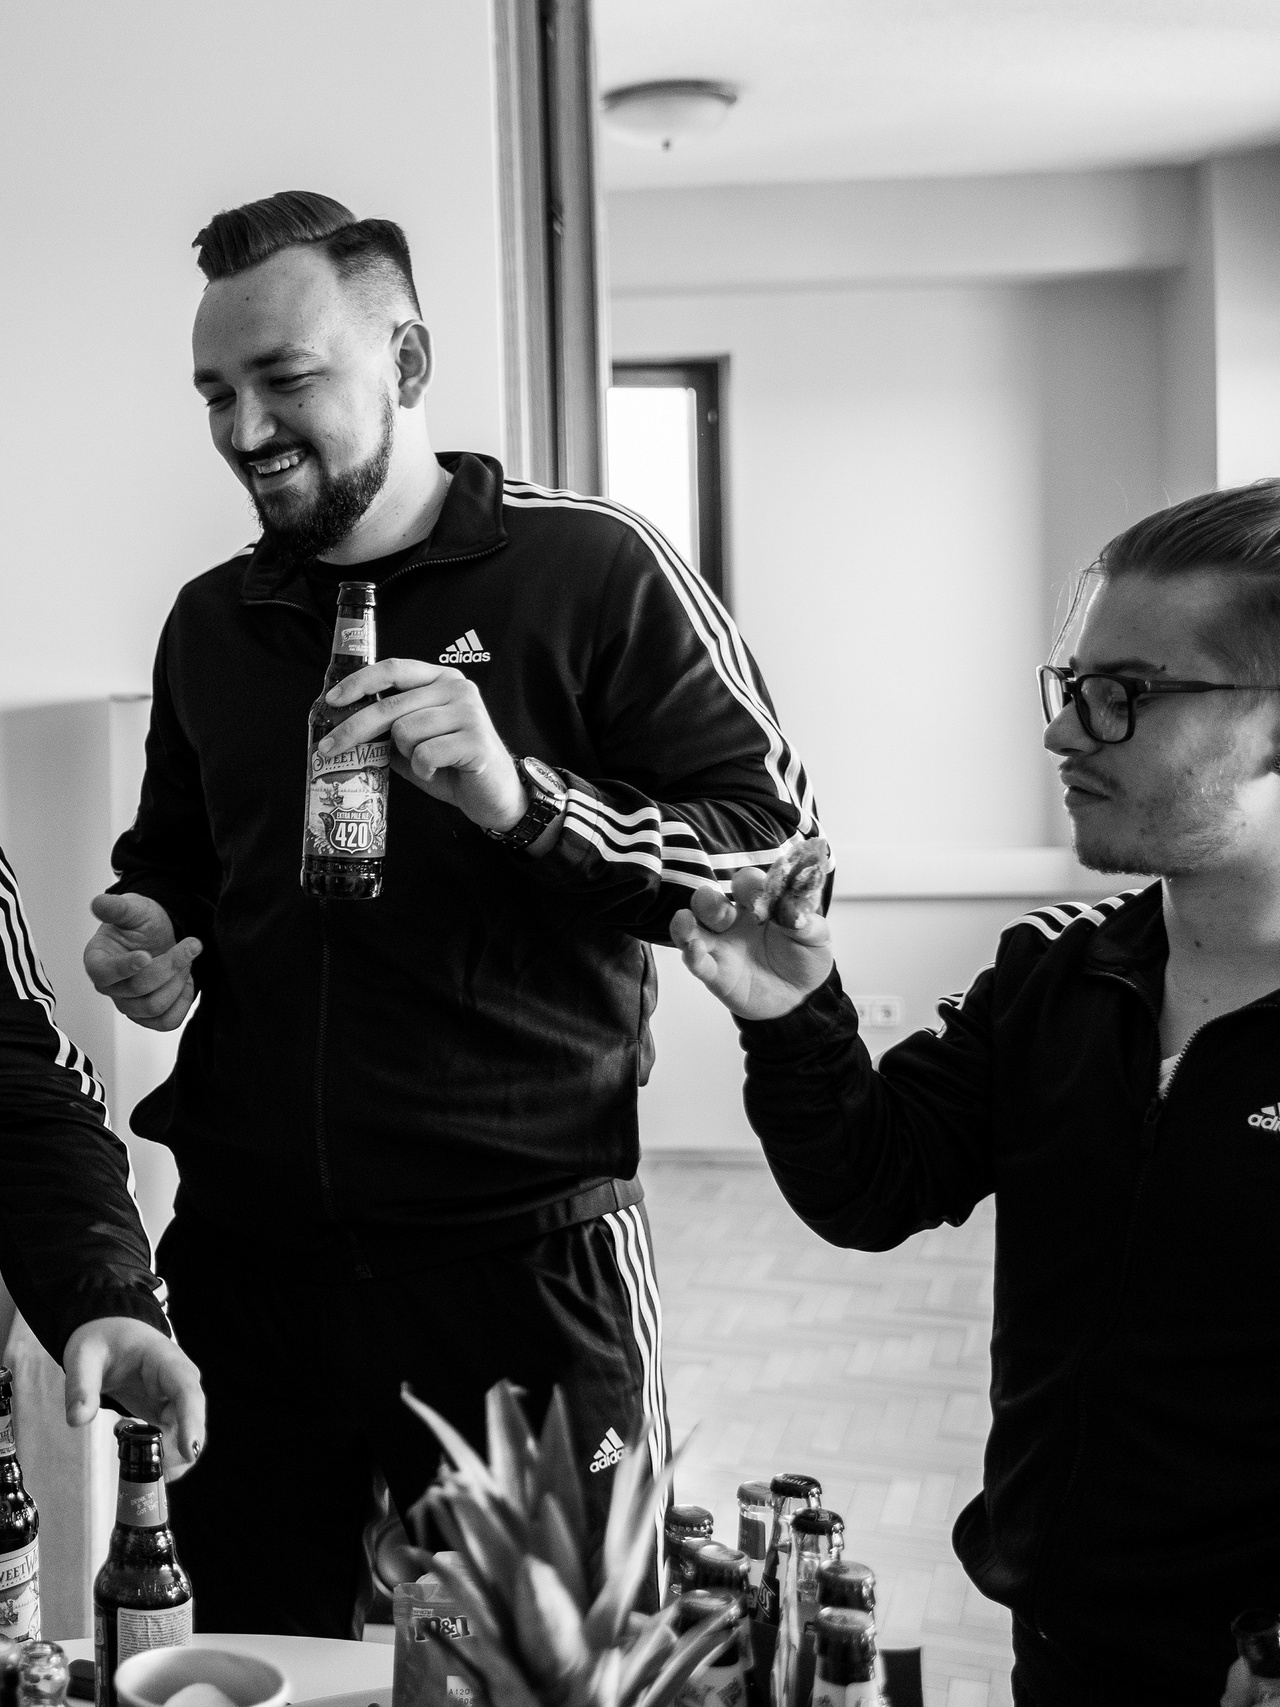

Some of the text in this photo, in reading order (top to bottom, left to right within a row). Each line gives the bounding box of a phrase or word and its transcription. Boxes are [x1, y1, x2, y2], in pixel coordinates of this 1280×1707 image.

[438, 651, 491, 664] adidas
[335, 822, 368, 848] 420
[589, 1448, 625, 1473] adida
